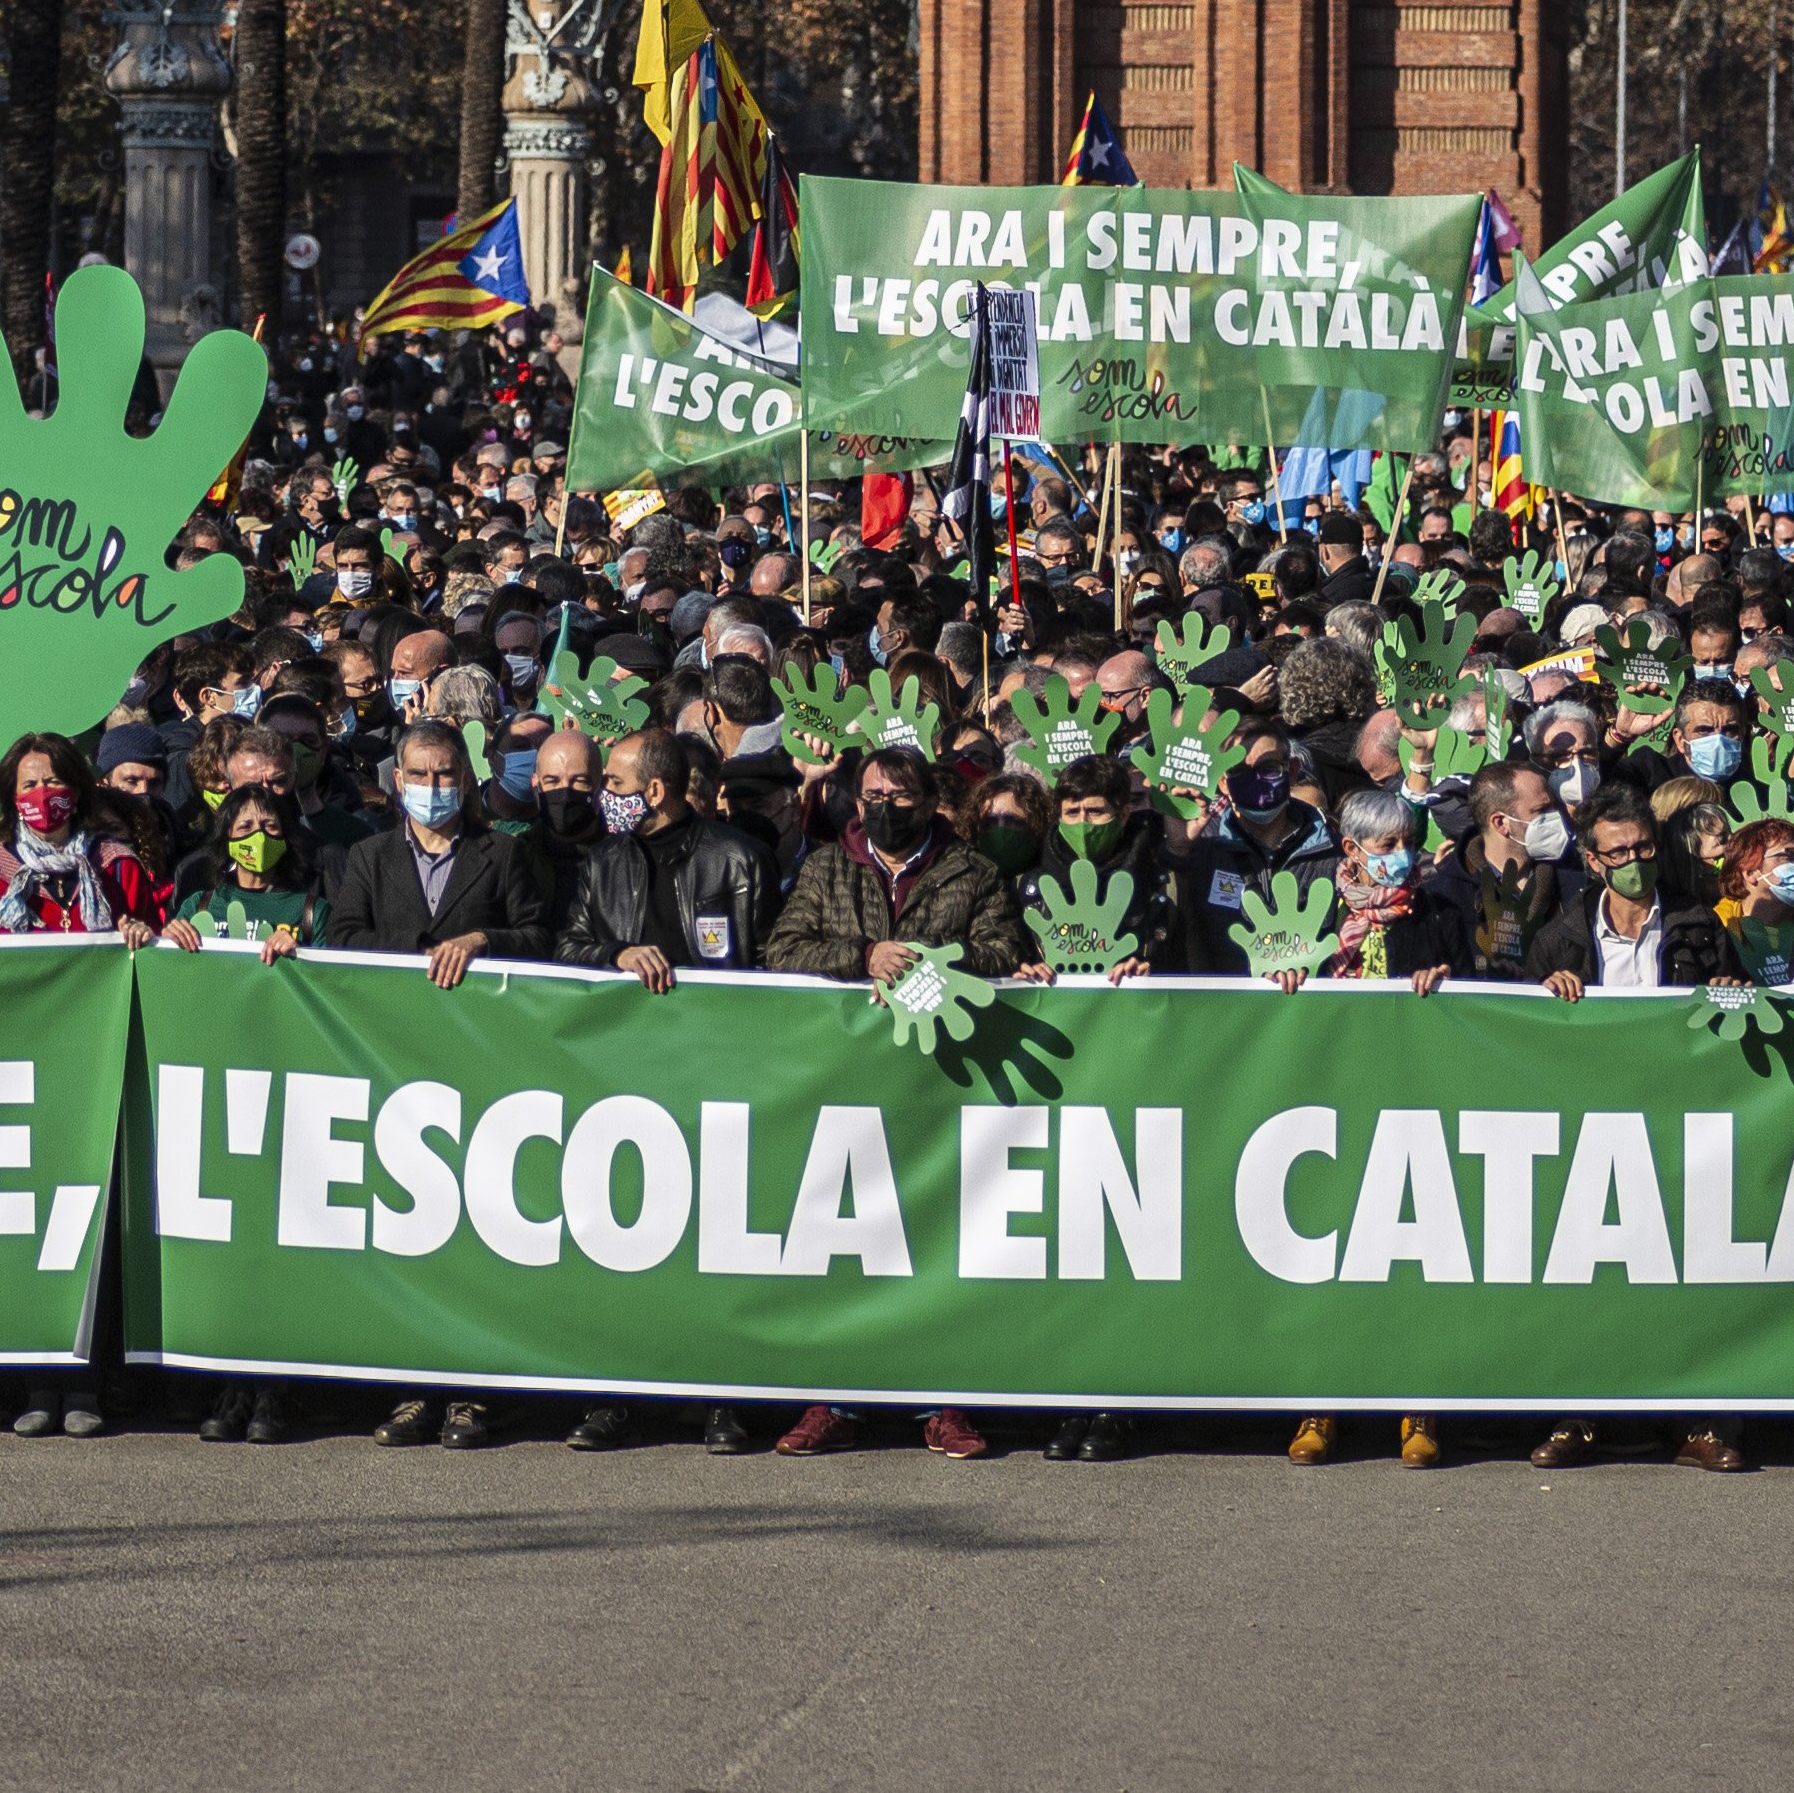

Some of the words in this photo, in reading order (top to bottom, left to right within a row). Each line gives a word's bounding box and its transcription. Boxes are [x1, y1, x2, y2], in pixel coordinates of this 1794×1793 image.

[913, 209, 1028, 268] ARA
[1049, 209, 1065, 269] I
[1113, 282, 1194, 344] EN
[1652, 308, 1676, 362] I
[1055, 355, 1146, 393] som
[1722, 357, 1790, 409] EN
[1079, 369, 1197, 423] escola
[1623, 658, 1627, 666] I
[1636, 653, 1655, 661] ARA
[1622, 673, 1636, 682] EN
[1625, 665, 1667, 677] L'ESCOLA
[786, 697, 828, 720] som
[794, 711, 846, 738] escola
[1044, 922, 1090, 940] som
[1056, 928, 1115, 954] escola
[1248, 930, 1292, 950] som
[1260, 932, 1317, 962] escola
[155, 1064, 913, 1277] L'ESCOLA
[959, 1104, 1183, 1281] EN
